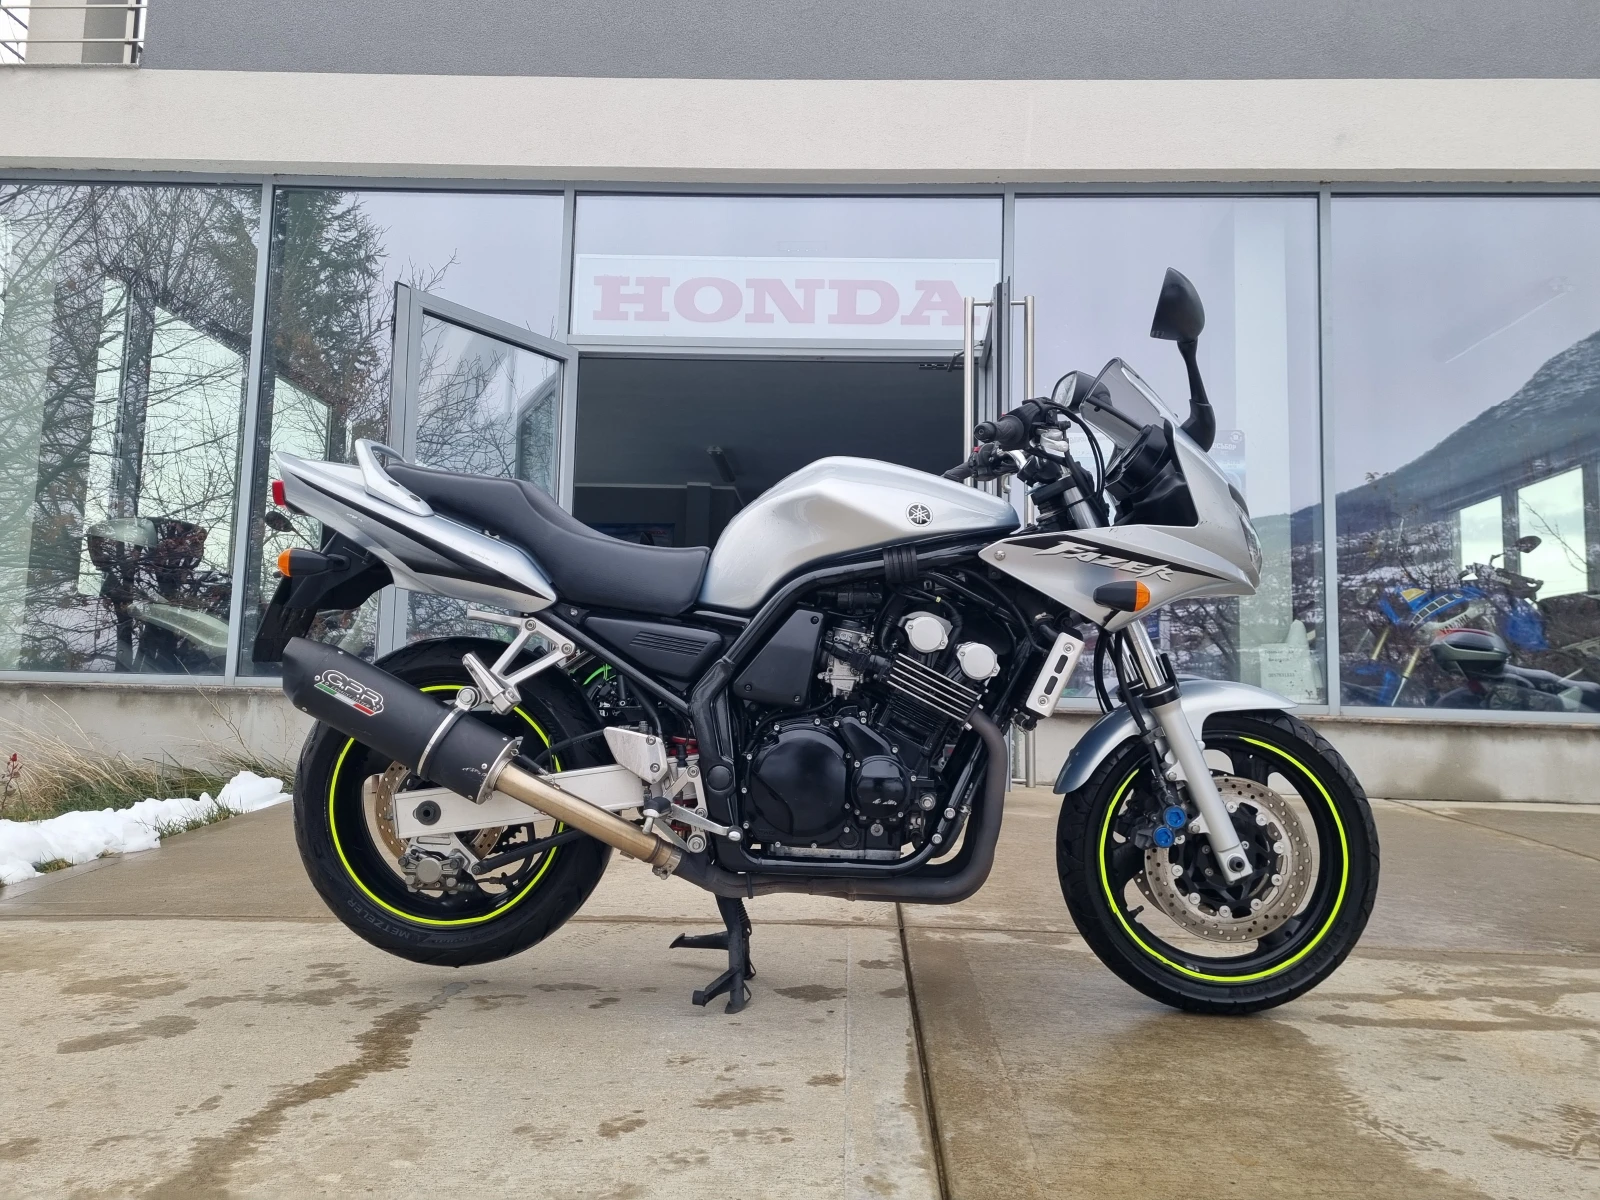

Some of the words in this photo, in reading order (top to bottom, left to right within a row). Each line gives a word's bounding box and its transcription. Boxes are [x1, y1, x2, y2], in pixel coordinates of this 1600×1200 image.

[592, 275, 981, 326] HONDA
[1033, 540, 1177, 582] FAZER
[1439, 614, 1471, 634] YAMAHA
[346, 898, 411, 940] METZELER
